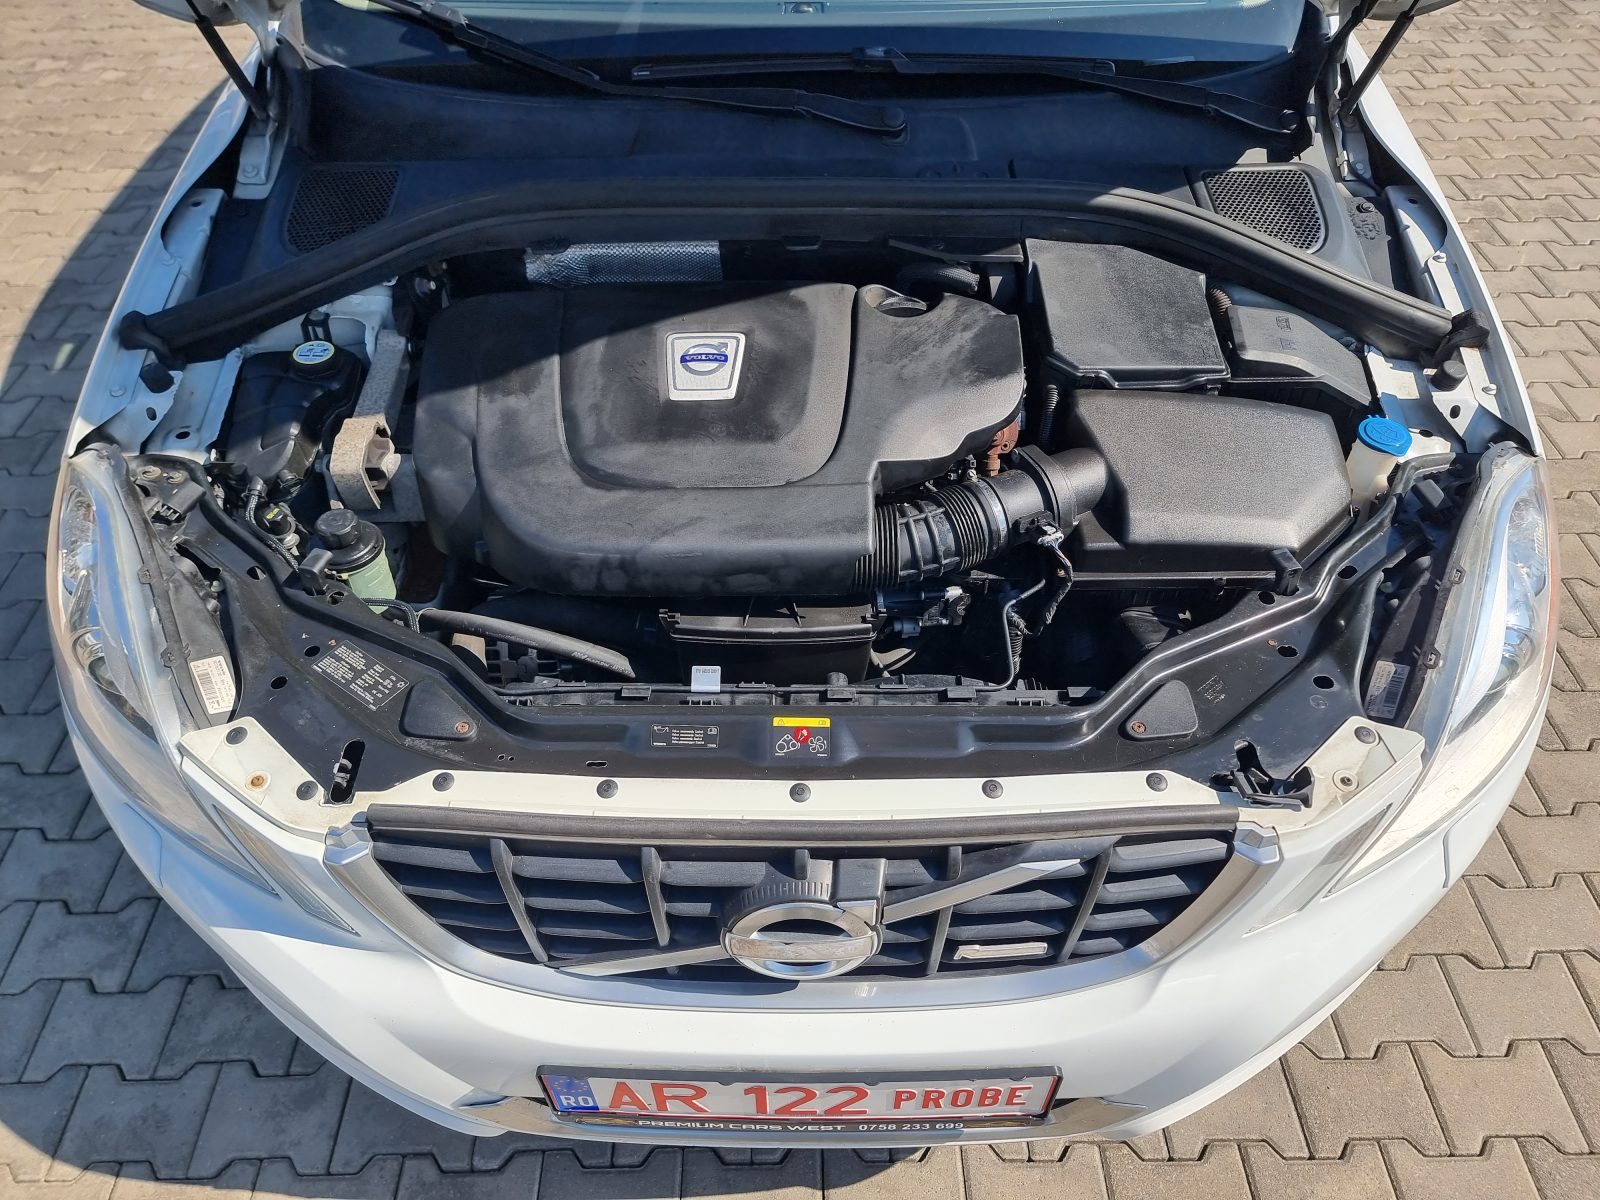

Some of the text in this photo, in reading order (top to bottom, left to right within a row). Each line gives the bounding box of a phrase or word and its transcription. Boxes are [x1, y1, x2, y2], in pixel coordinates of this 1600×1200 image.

[560, 1095, 594, 1108] RO
[608, 1081, 1034, 1116] AR 122 PROBE
[638, 1119, 724, 1129] PREMIUM
[728, 1122, 783, 1131] CARS
[935, 1122, 964, 1130] 699
